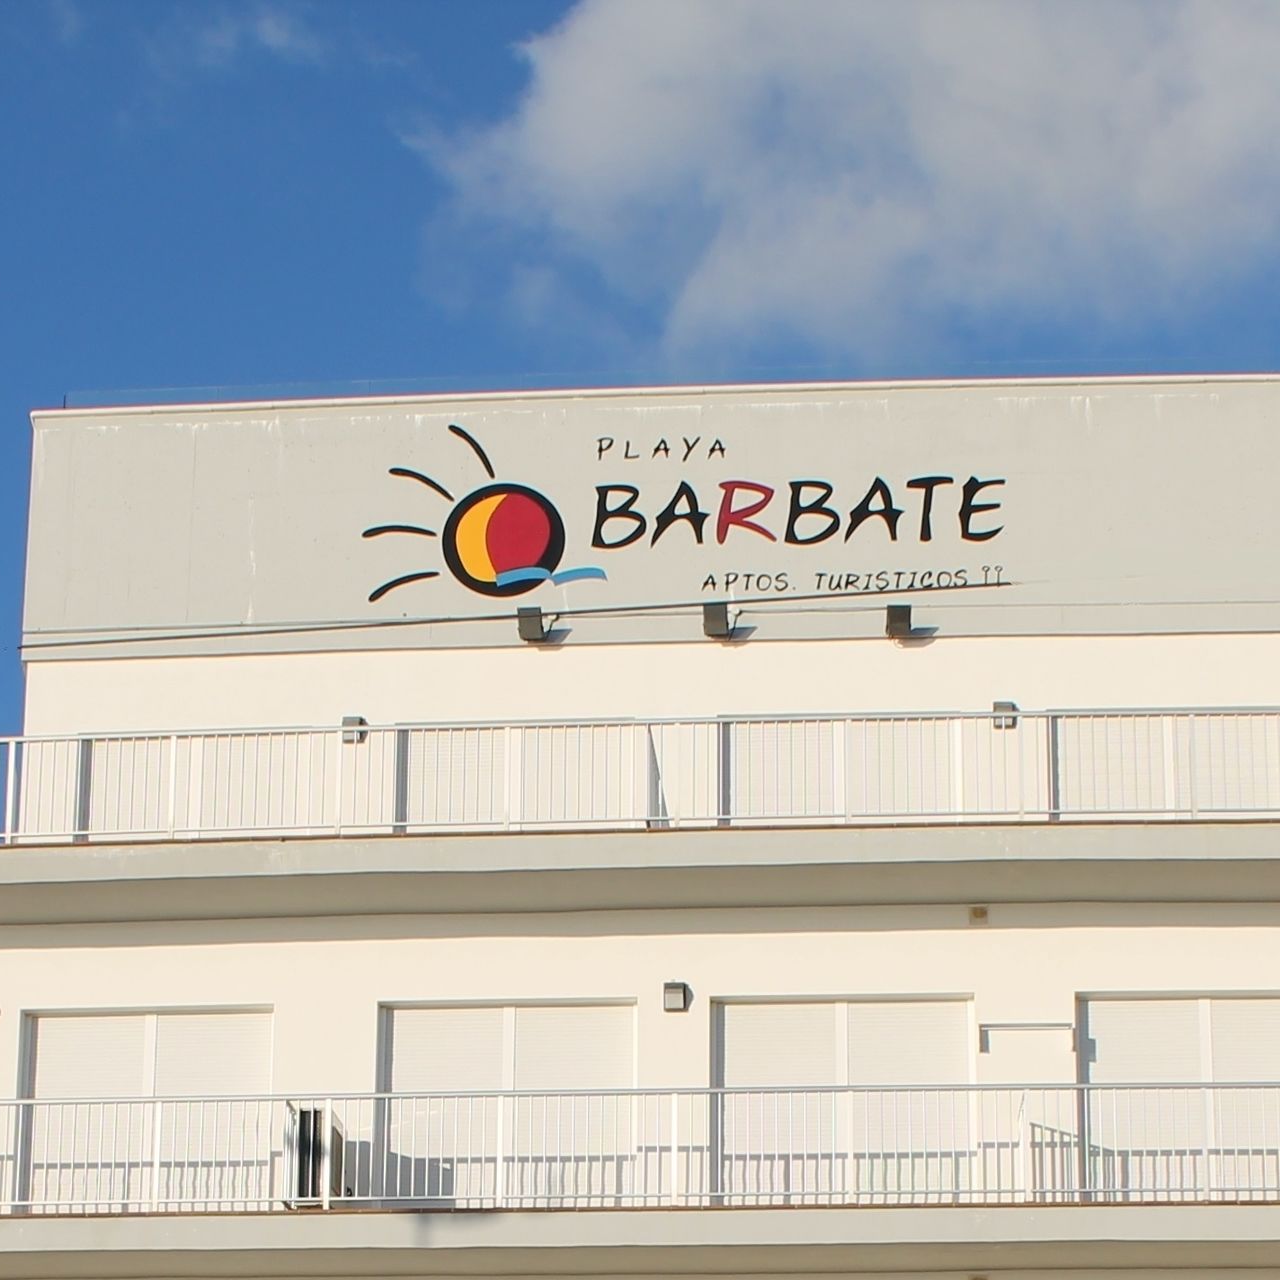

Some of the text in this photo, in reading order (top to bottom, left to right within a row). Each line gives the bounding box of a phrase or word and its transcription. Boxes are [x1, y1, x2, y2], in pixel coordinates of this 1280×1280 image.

[596, 436, 728, 461] PLAYA
[591, 476, 1006, 549] BARBATE
[701, 568, 968, 592] APTOS. TURISTICOS
